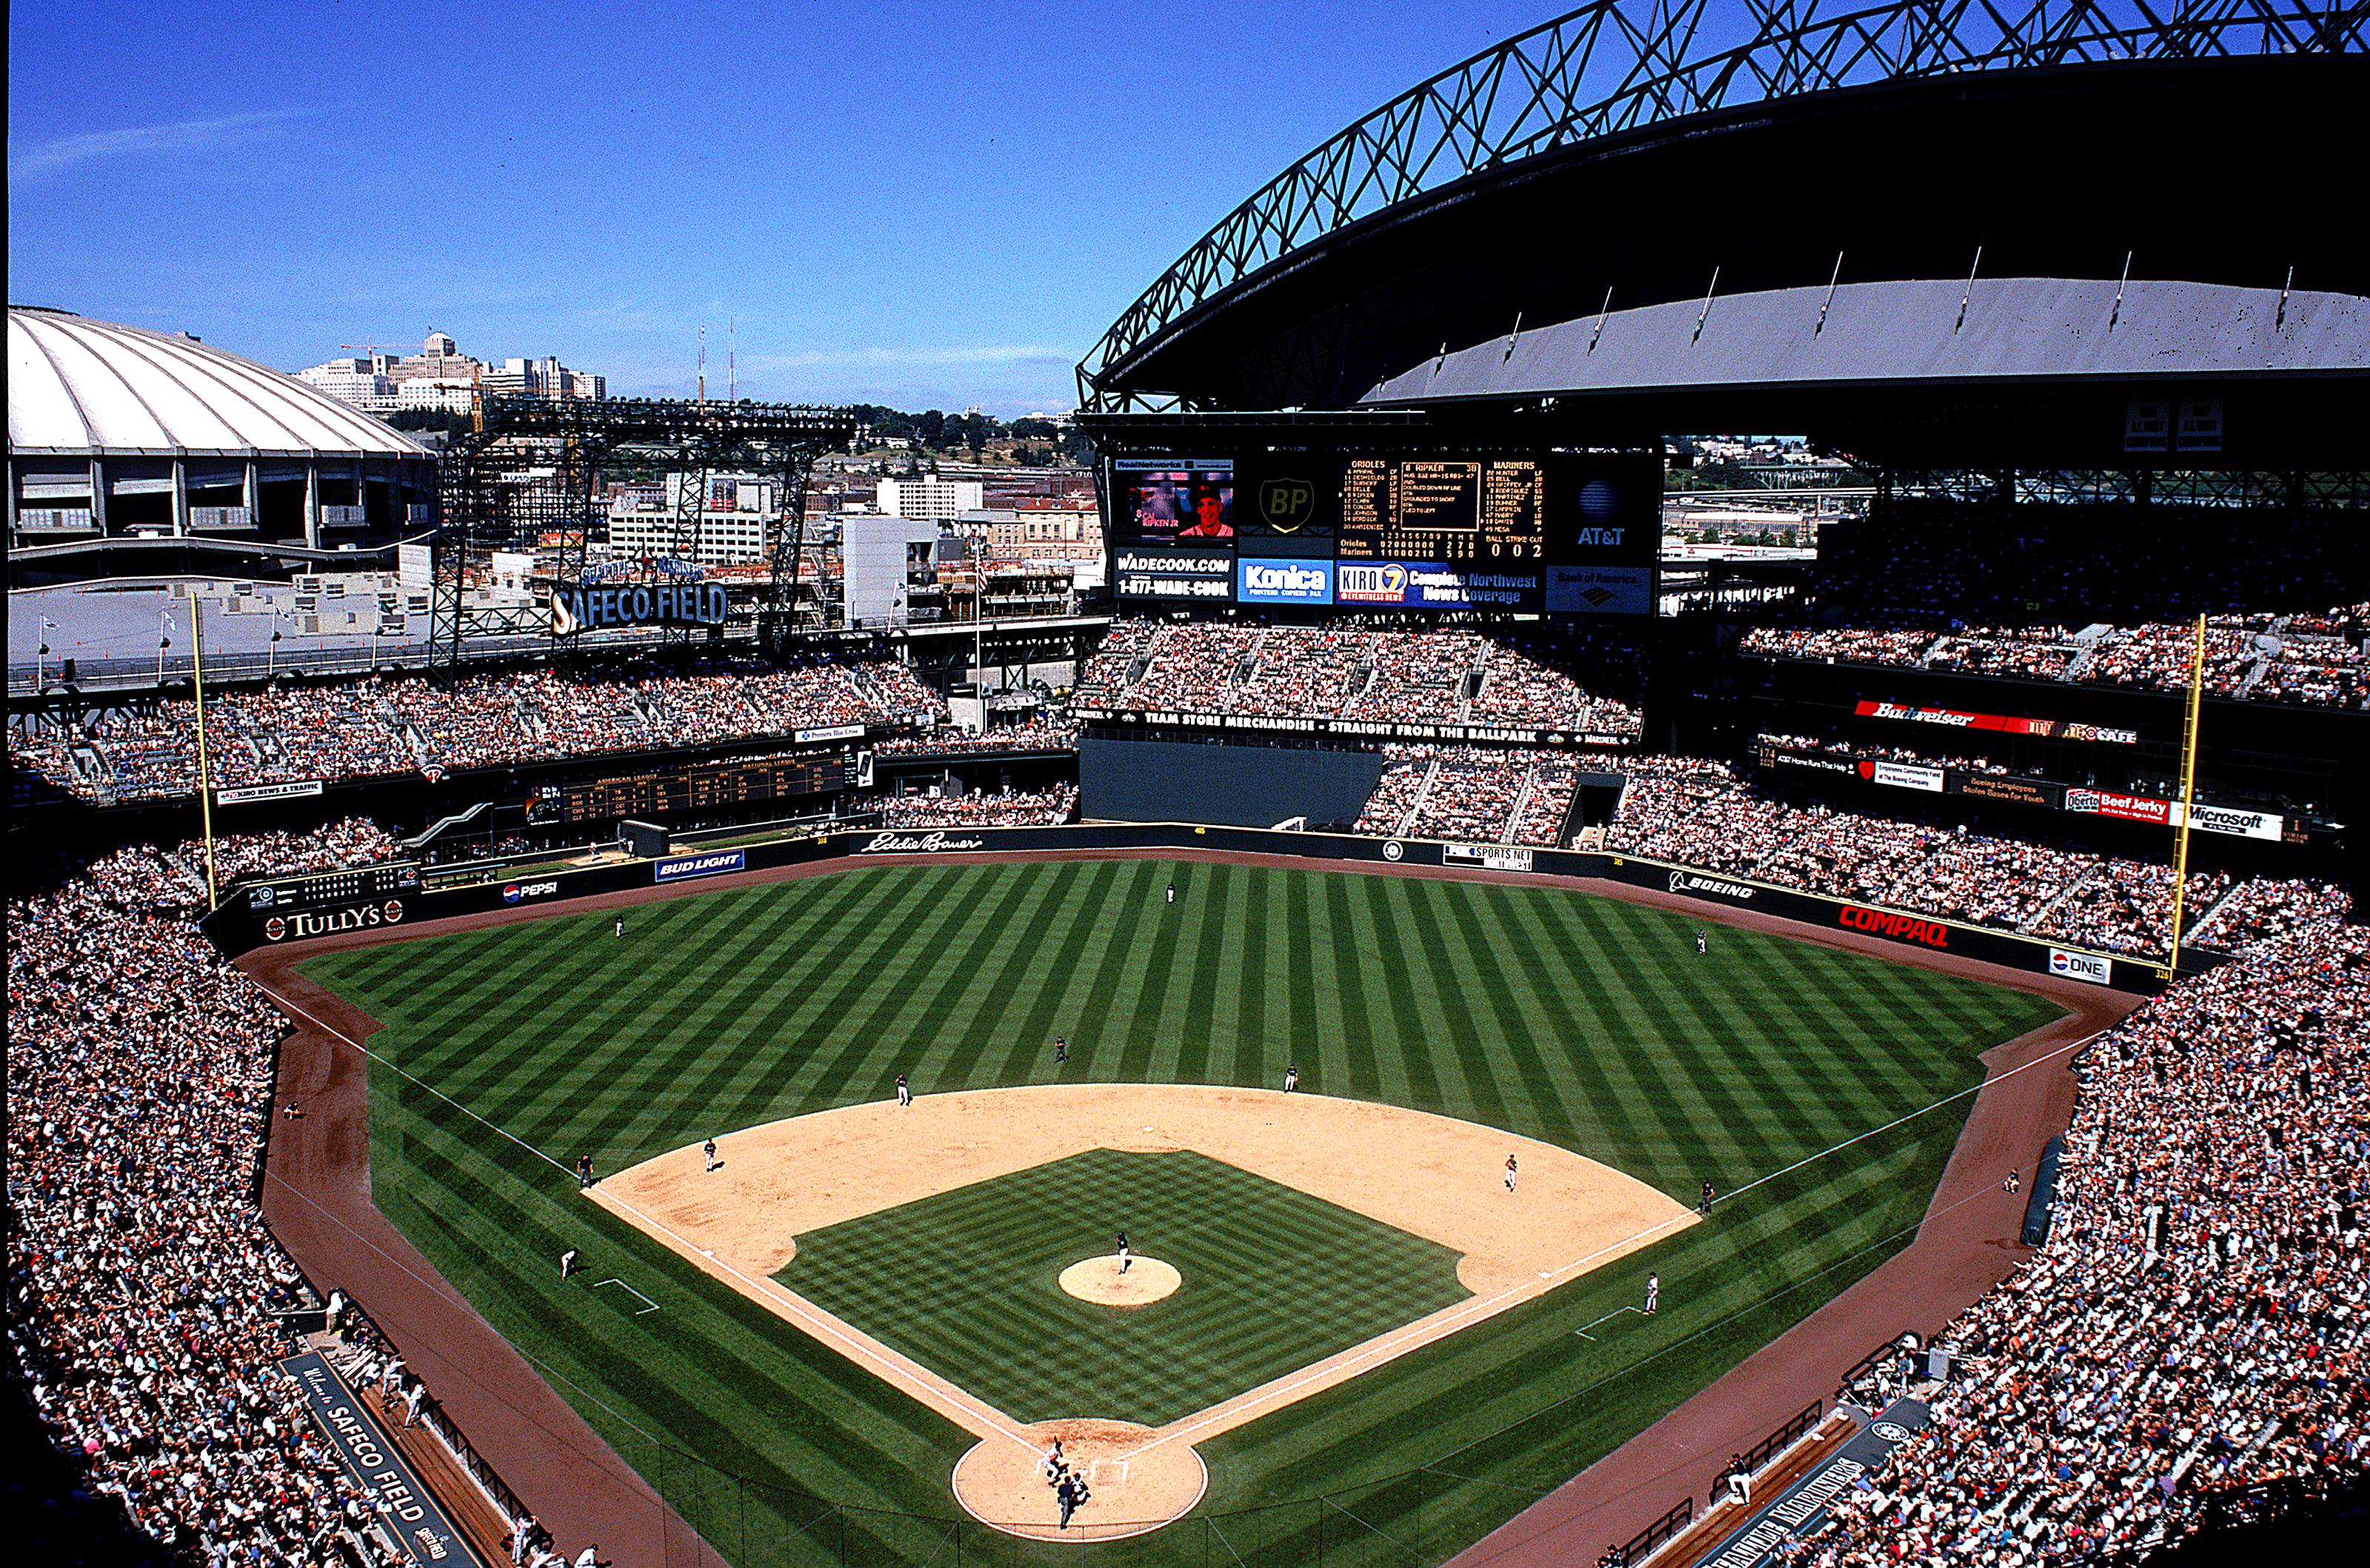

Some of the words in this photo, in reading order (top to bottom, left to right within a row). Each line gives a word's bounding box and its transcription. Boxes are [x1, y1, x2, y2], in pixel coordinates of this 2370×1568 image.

[1352, 460, 1386, 469] ORIOLES
[1494, 461, 1535, 470] MARINERS
[1270, 489, 1309, 514] BP
[1136, 510, 1143, 518] 8
[1142, 519, 1170, 527] RIPKEN
[1341, 539, 1367, 547] Orioles
[1578, 527, 1626, 546] AT&T
[1341, 547, 1373, 556] Mariners
[1446, 550, 1452, 558] 5
[1458, 550, 1463, 558] 9
[1469, 550, 1474, 558] 0
[1492, 544, 1501, 556] 0
[1513, 544, 1522, 557] 0
[1533, 544, 1542, 557] 2
[1118, 553, 1230, 573] WADECOOK.COM
[581, 558, 630, 586] SEATTLE
[1246, 565, 1326, 591] Konica
[1409, 570, 1466, 587] Complete
[1469, 573, 1537, 588] Northwest
[1558, 572, 1583, 583] Bank
[1584, 573, 1595, 583] of
[1118, 579, 1229, 596] 1-877-WADE-COOK
[1343, 570, 1377, 591] KIRO
[1383, 570, 1404, 592] 7
[1385, 593, 1403, 601] NEWS
[1423, 586, 1460, 601] News
[1461, 588, 1521, 605] Coverage
[551, 587, 650, 635] SAFECO
[657, 583, 727, 625] FIELD
[1075, 709, 1104, 719] MARINERS
[1873, 702, 1975, 727] Budweiser
[1145, 712, 1179, 724] TEAM
[1182, 714, 1221, 727] STORE
[1225, 715, 1315, 731] MERCHANDISE
[1329, 721, 1393, 735] STRAIGHT
[1398, 724, 1435, 737] FROM
[1440, 726, 1464, 738] THE
[1469, 728, 1536, 742] BALLPARK
[1585, 735, 1620, 744] MARINERS
[2097, 729, 2137, 743] CAFE
[1760, 749, 1775, 758] 174
[1792, 758, 1808, 766] Home
[1809, 759, 1820, 768] Runs
[1821, 761, 1833, 769] That
[1833, 762, 1846, 772] Help
[1879, 764, 1903, 775] Employees
[1903, 767, 1929, 778] Community
[1929, 770, 1940, 778] Fund
[428, 770, 439, 781] 42
[1892, 775, 1908, 784] Boeing
[1908, 777, 1929, 787] Company
[258, 787, 280, 795] NEWS
[290, 783, 318, 792] TRAFFIC
[1963, 784, 1986, 795] Stolen
[1987, 788, 2009, 799] Bases
[2010, 791, 2023, 801] for
[2023, 794, 2044, 804] Youth
[1971, 777, 1995, 788] Boeing
[1997, 781, 2037, 794] Employees
[2068, 795, 2099, 807] Oberto
[2101, 794, 2132, 809] Beef
[2132, 796, 2166, 815] Jerky
[2189, 805, 2263, 829] Microsoft
[2294, 820, 2300, 831] 1
[861, 833, 925, 852] Eddie
[918, 833, 984, 850] Bauer
[1476, 847, 1511, 859] SPORTS
[1514, 850, 1531, 860] NET
[660, 859, 693, 875] BUD
[695, 854, 740, 870] LIGHT
[520, 881, 558, 898] PEPSI
[1687, 877, 1752, 898] BOEING
[287, 905, 380, 937] TULLY'S
[1840, 905, 1948, 947] COMPAQ
[2070, 958, 2103, 975] ONE
[2156, 970, 2169, 980] 326
[327, 1407, 384, 1467] SAFECO
[373, 1471, 425, 1522] FIELD
[1701, 1519, 1791, 1568] EATTLE
[1769, 1457, 1866, 1527] MARINERS
